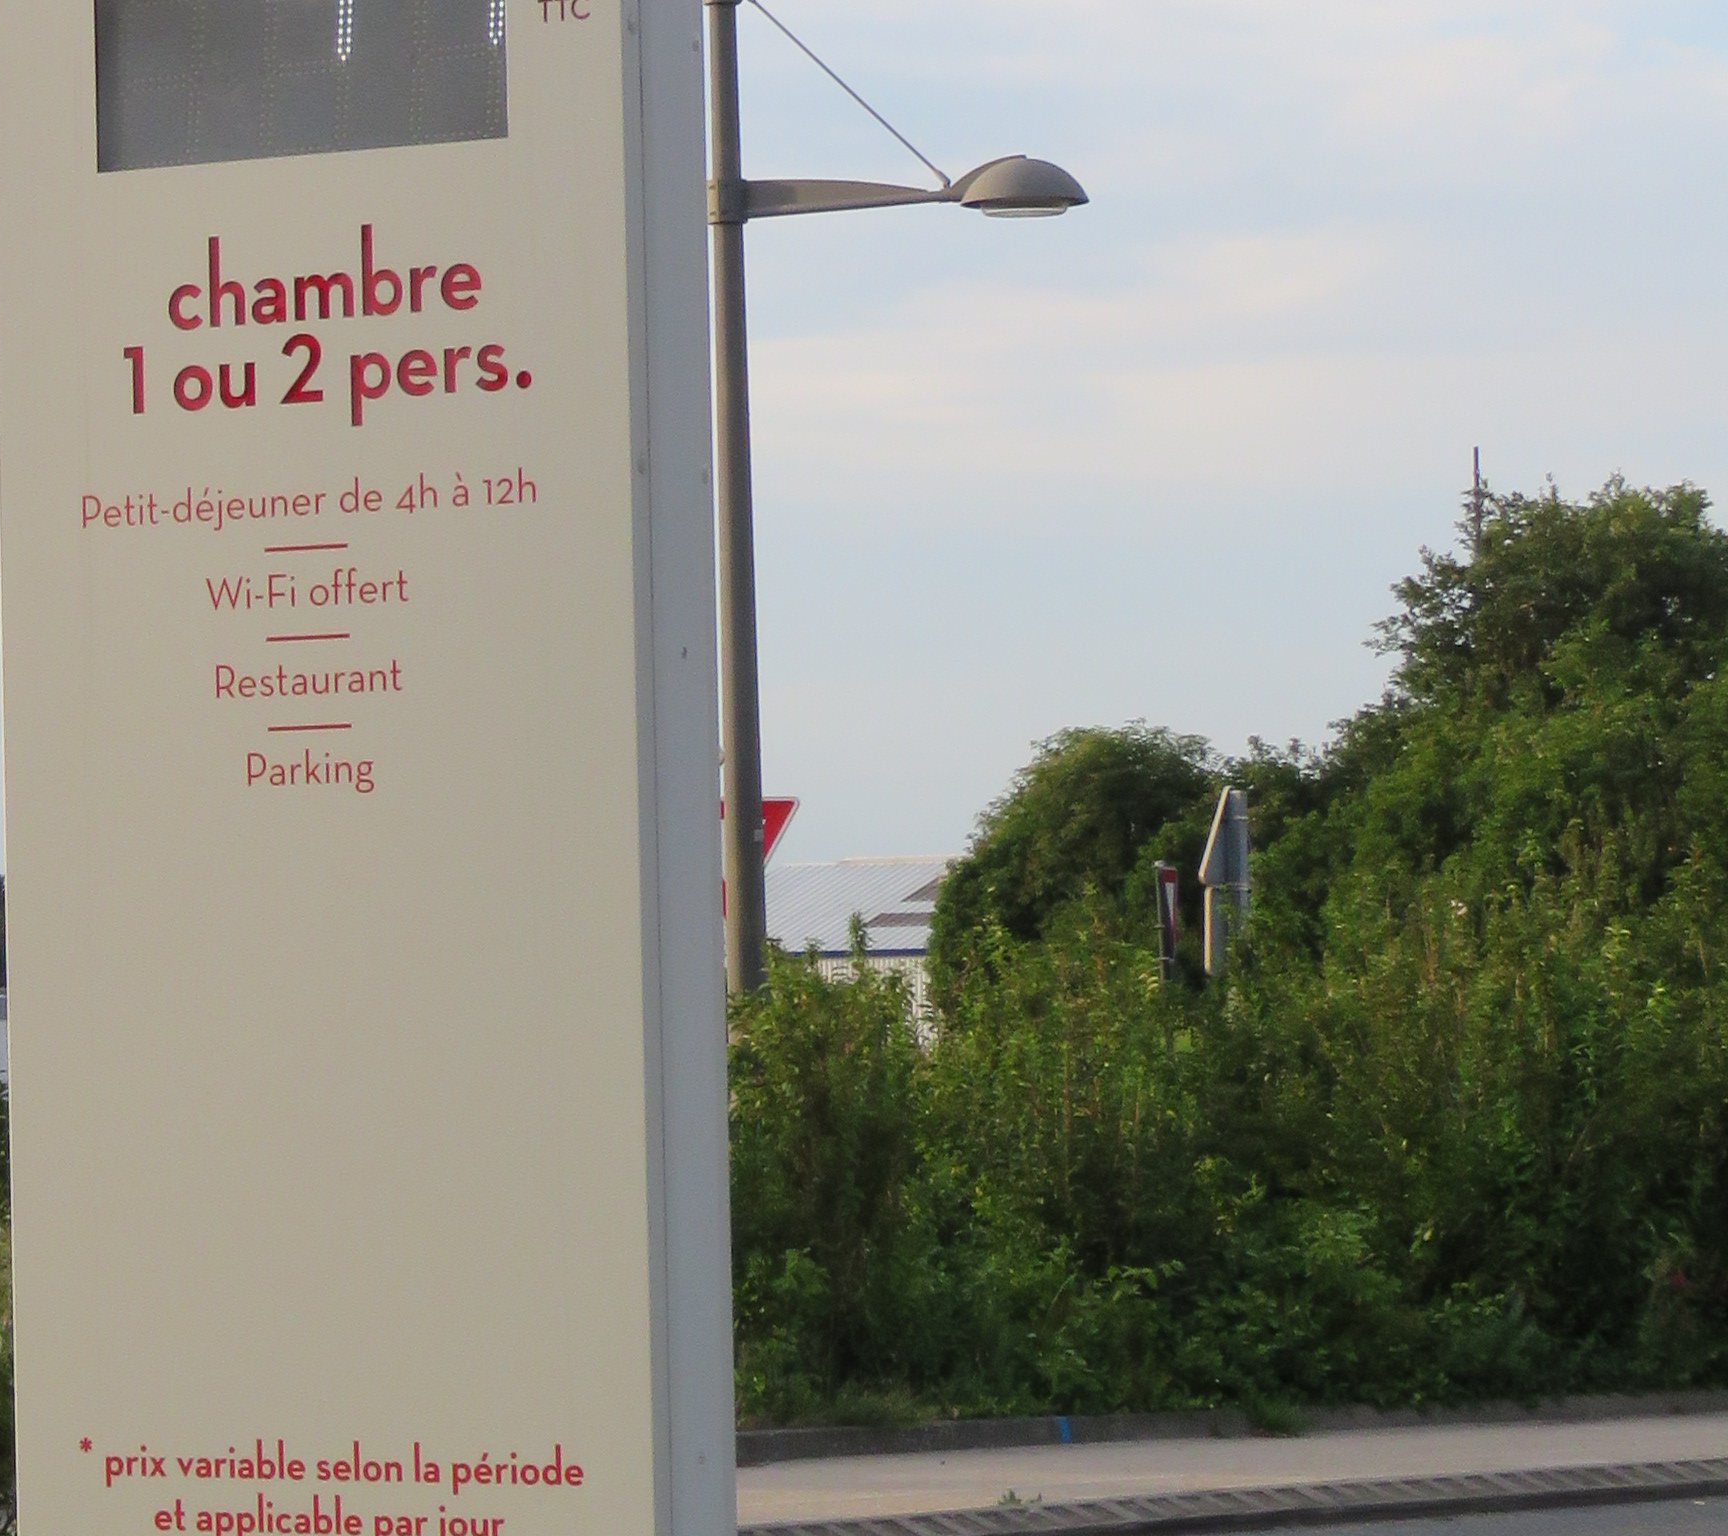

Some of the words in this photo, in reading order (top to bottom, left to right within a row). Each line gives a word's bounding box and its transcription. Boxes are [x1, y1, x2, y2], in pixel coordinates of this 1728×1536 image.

[168, 223, 484, 331] chambre
[123, 345, 147, 415] 1
[173, 361, 258, 413] ou
[280, 332, 325, 406] 2
[350, 341, 534, 428] pers.
[80, 484, 326, 531] Petit-déjeuner
[337, 476, 384, 514] de
[395, 472, 439, 515] 4h
[450, 471, 470, 507] à
[482, 466, 539, 506] 12h
[205, 572, 297, 611] Wi-Fi
[308, 565, 410, 608] offert
[214, 658, 403, 700] Restaurant
[245, 747, 375, 795] Parking
[104, 1443, 167, 1489] prix
[176, 1438, 307, 1482] variable
[316, 1439, 404, 1484] selon
[413, 1440, 441, 1484] la
[451, 1443, 585, 1496] période
[152, 1498, 187, 1534] et
